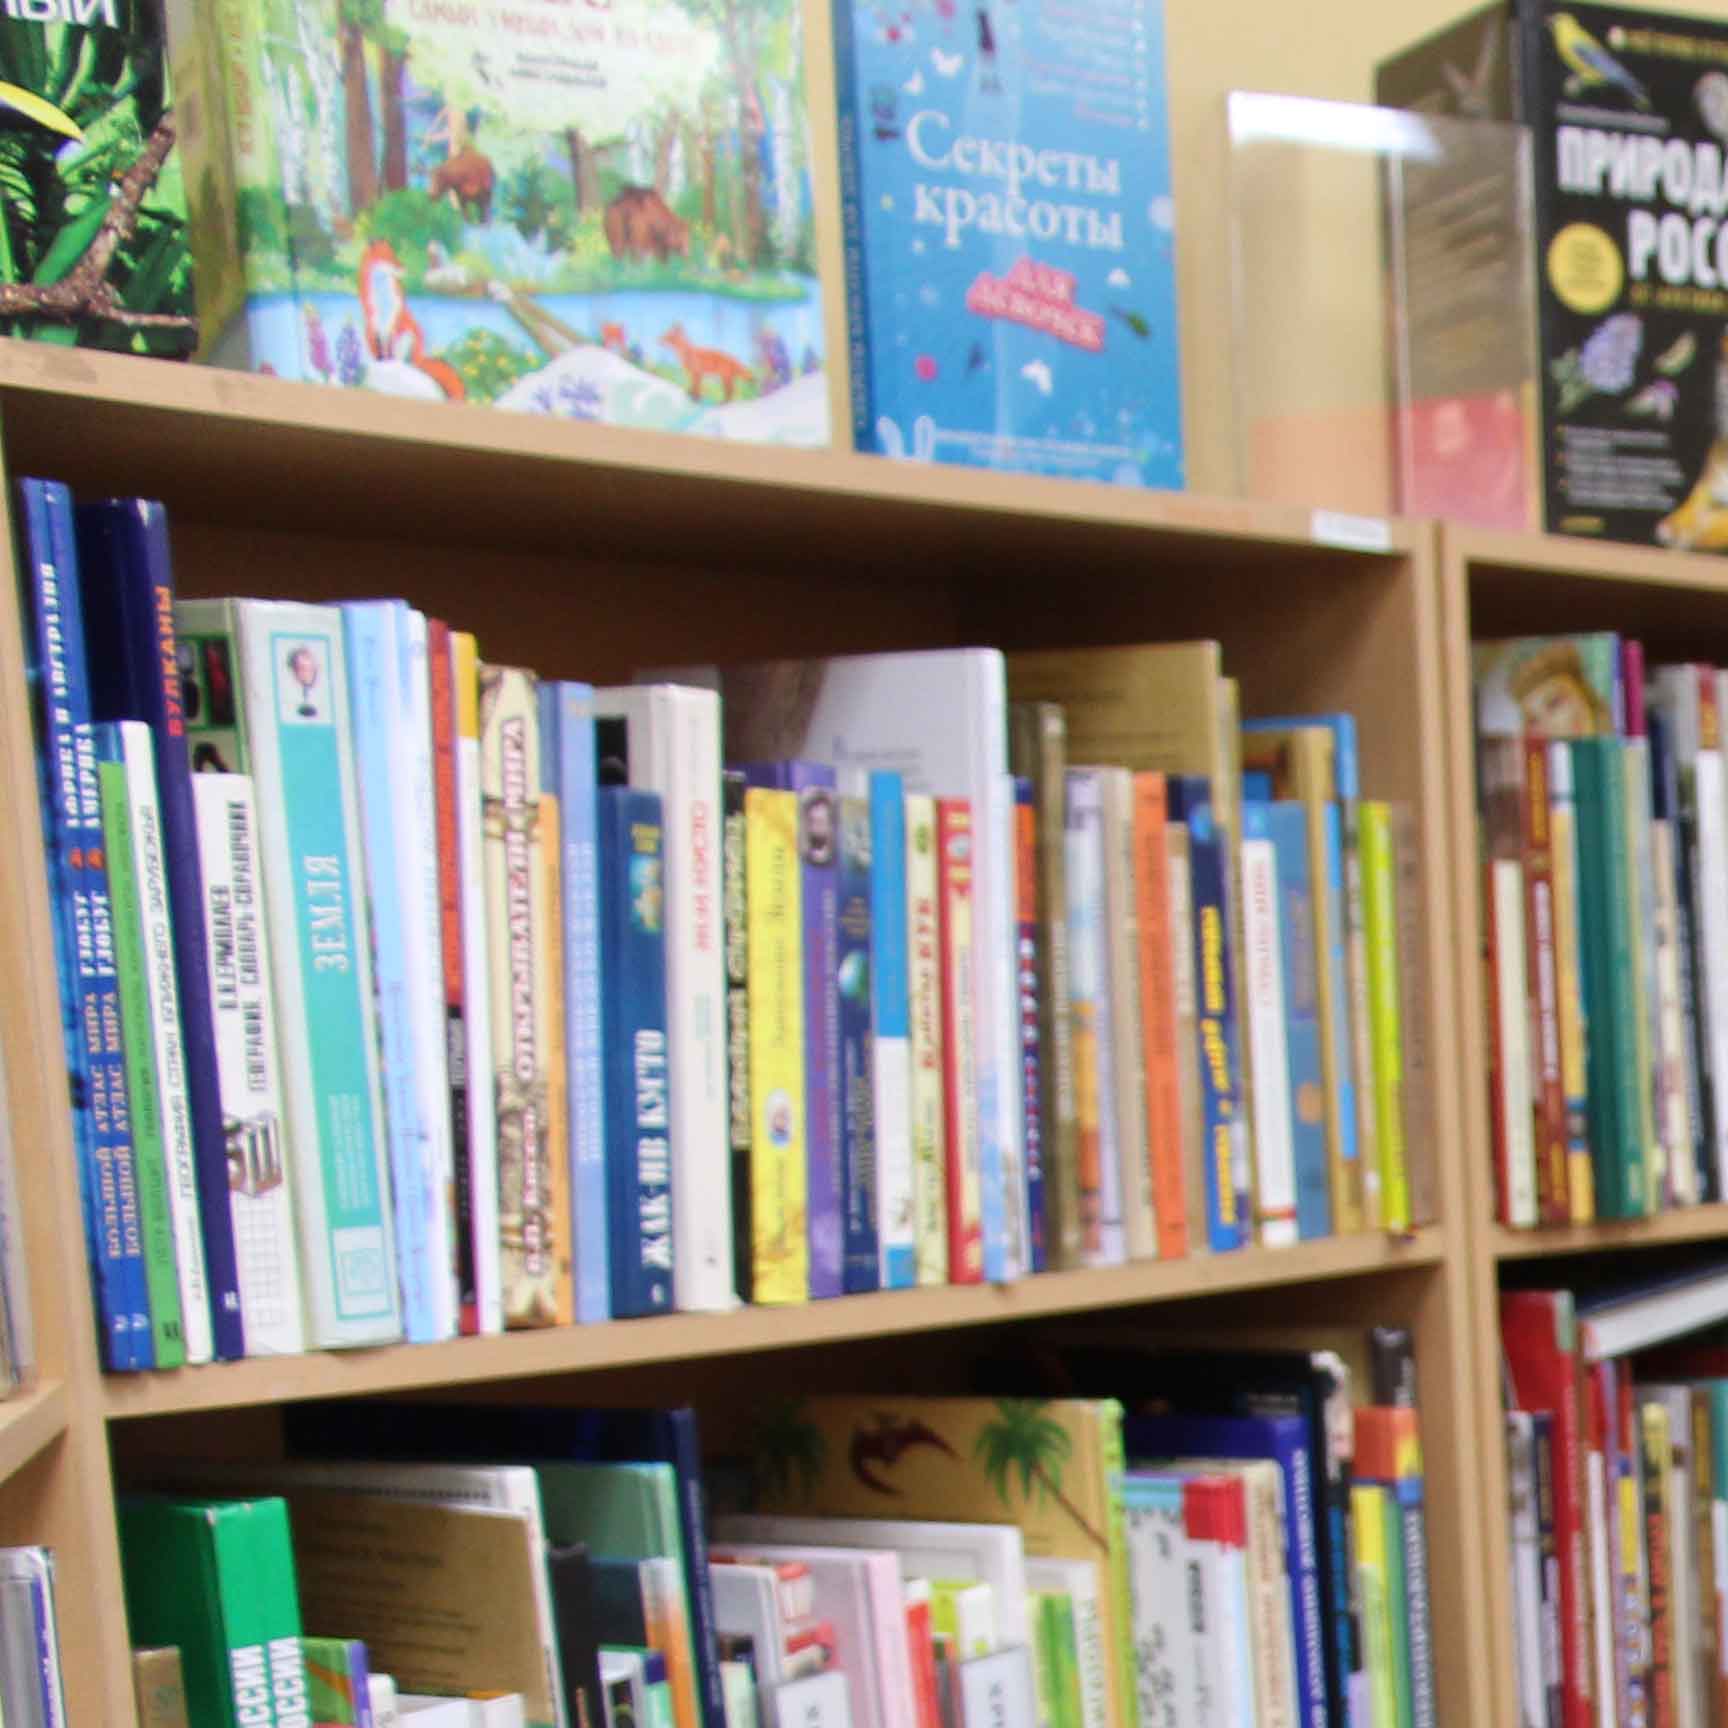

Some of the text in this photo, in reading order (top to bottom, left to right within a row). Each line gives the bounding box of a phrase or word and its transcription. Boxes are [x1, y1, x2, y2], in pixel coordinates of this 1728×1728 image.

[905, 108, 1121, 196] Секреты
[914, 183, 1124, 249] красоты
[155, 586, 183, 737] ВУЛКАНЫ
[58, 733, 79, 828] АФРИКА
[73, 891, 97, 978] ГЛОБУС
[303, 853, 350, 974] ЗЕМЛЯ
[75, 723, 140, 1256] БОЛЬШОЙ АТЛАС МИРА ГЛОБУС АМЕРИКА
[85, 993, 102, 1055] МИРА
[91, 1065, 109, 1133] АТЛАС
[635, 1029, 666, 1129] КУСТО
[96, 1147, 122, 1258] БОЛЬШОЙ
